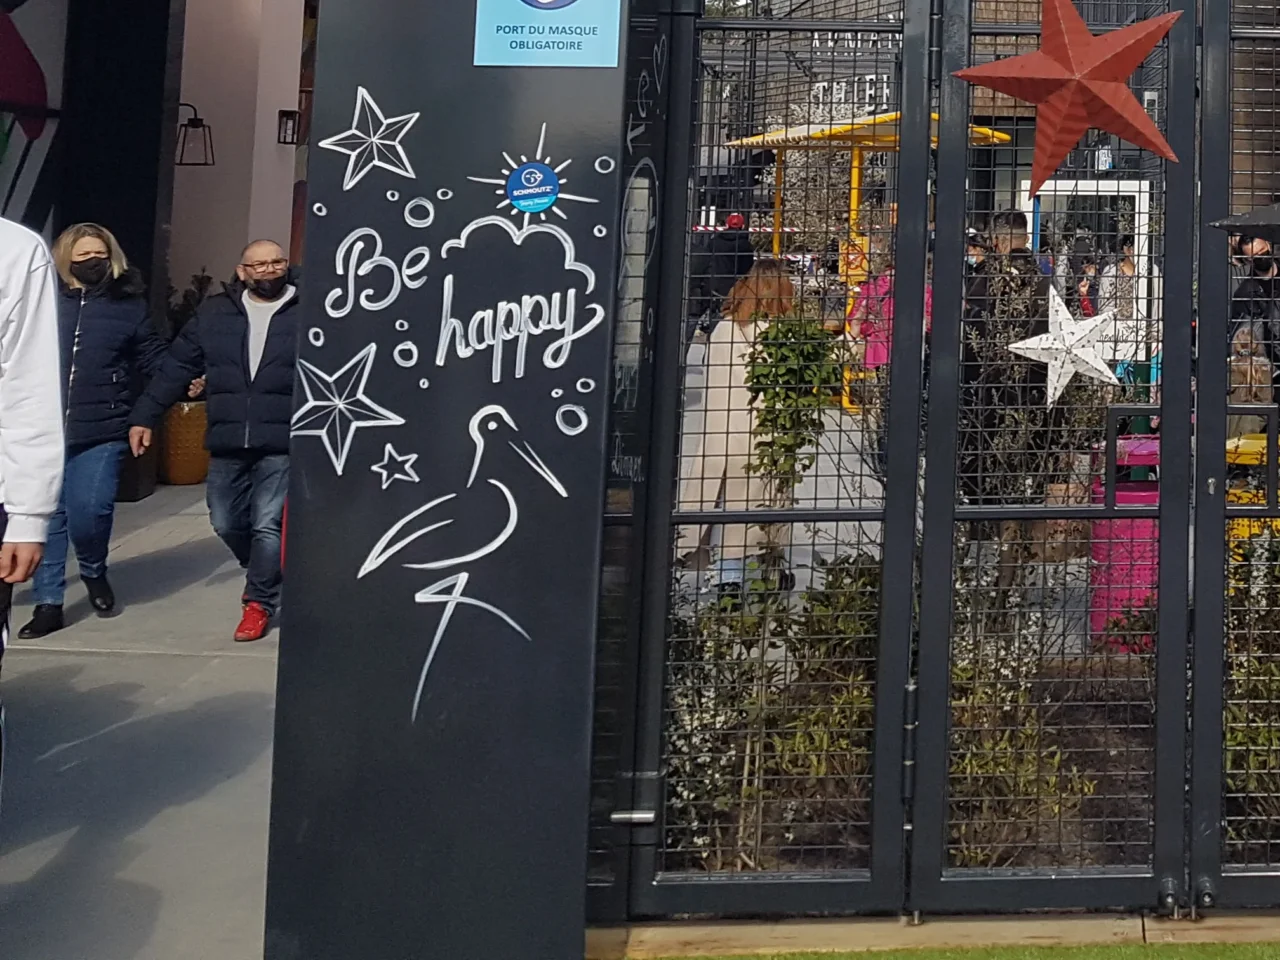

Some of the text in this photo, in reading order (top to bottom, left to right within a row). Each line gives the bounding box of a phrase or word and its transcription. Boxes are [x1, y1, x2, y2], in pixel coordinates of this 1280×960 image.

[495, 25, 599, 38] PORT DU MASQUE
[509, 40, 583, 51] OBLIGATOIRE
[325, 227, 431, 318] Be
[435, 274, 605, 383] happy
